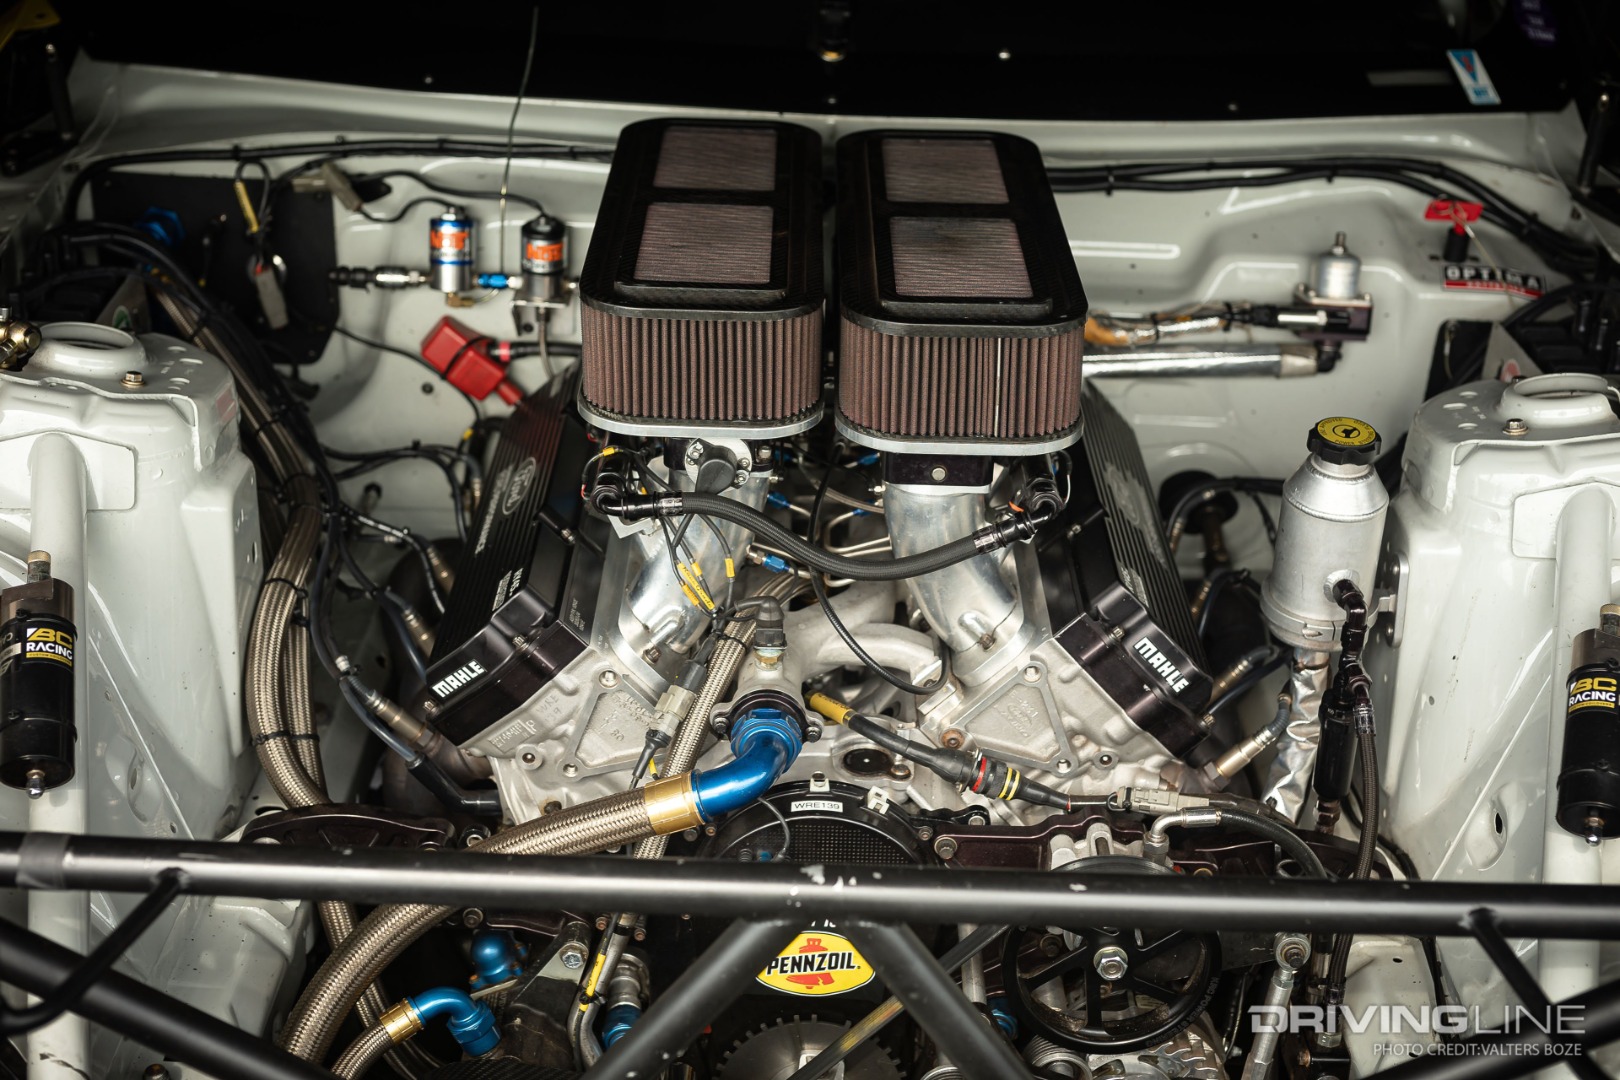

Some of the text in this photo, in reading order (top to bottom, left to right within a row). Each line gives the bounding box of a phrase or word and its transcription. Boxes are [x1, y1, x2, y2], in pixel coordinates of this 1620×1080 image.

[27, 627, 73, 650] BC
[26, 641, 73, 660] RACING
[1134, 636, 1190, 693] MAHLE
[432, 660, 486, 698] MAHLE
[1571, 677, 1618, 696] BC
[1569, 690, 1617, 707] RACING
[793, 801, 840, 810] WRE139
[765, 952, 856, 976] PENNZOIL
